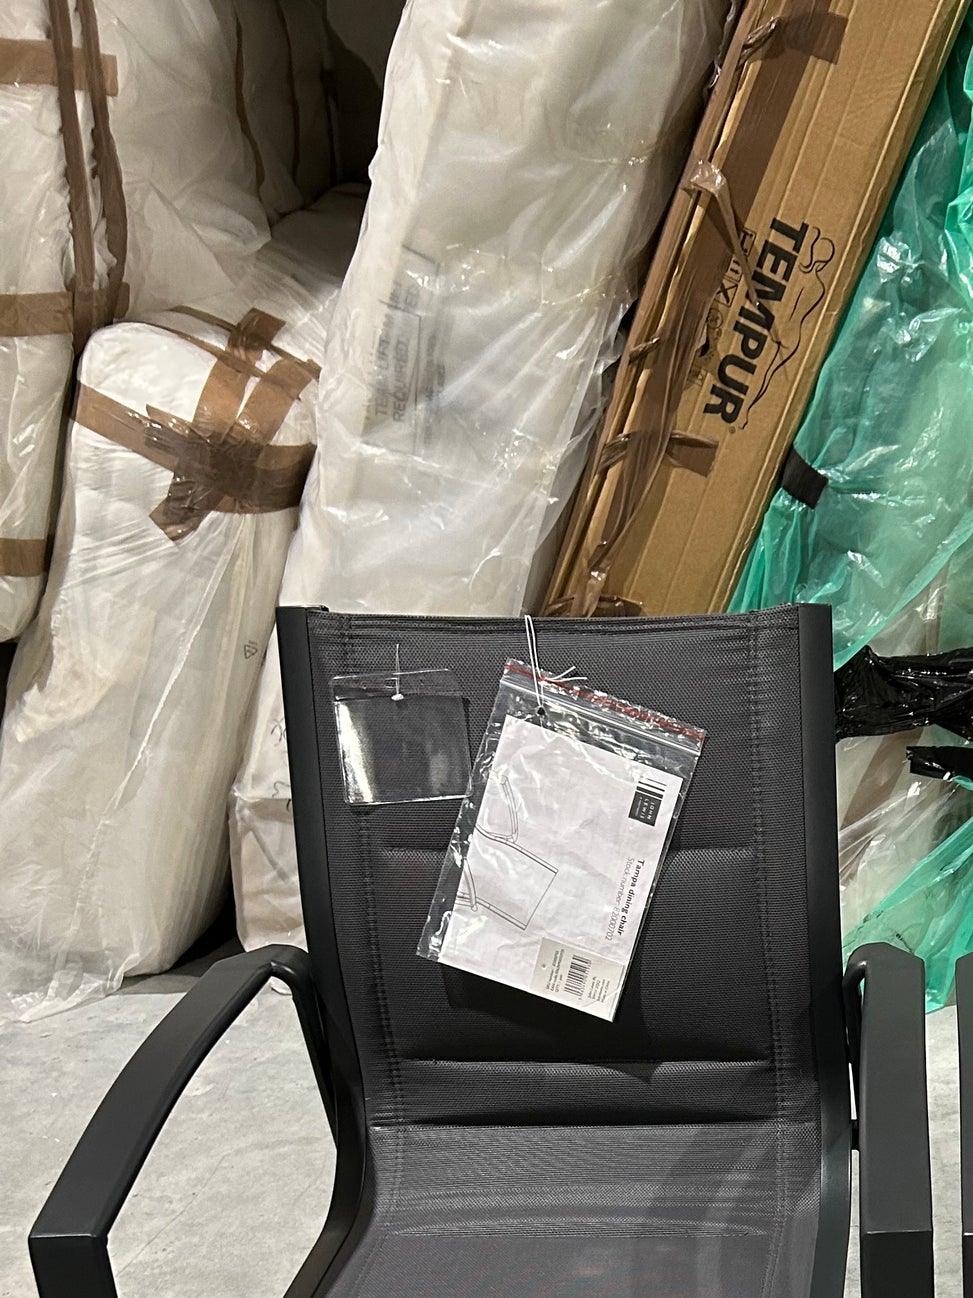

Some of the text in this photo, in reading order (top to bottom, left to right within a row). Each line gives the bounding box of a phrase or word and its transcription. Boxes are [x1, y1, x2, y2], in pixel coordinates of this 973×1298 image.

[703, 217, 809, 424] TEMPUR
[617, 859, 645, 937] Tampa dining chair
[623, 858, 635, 877] Stock
